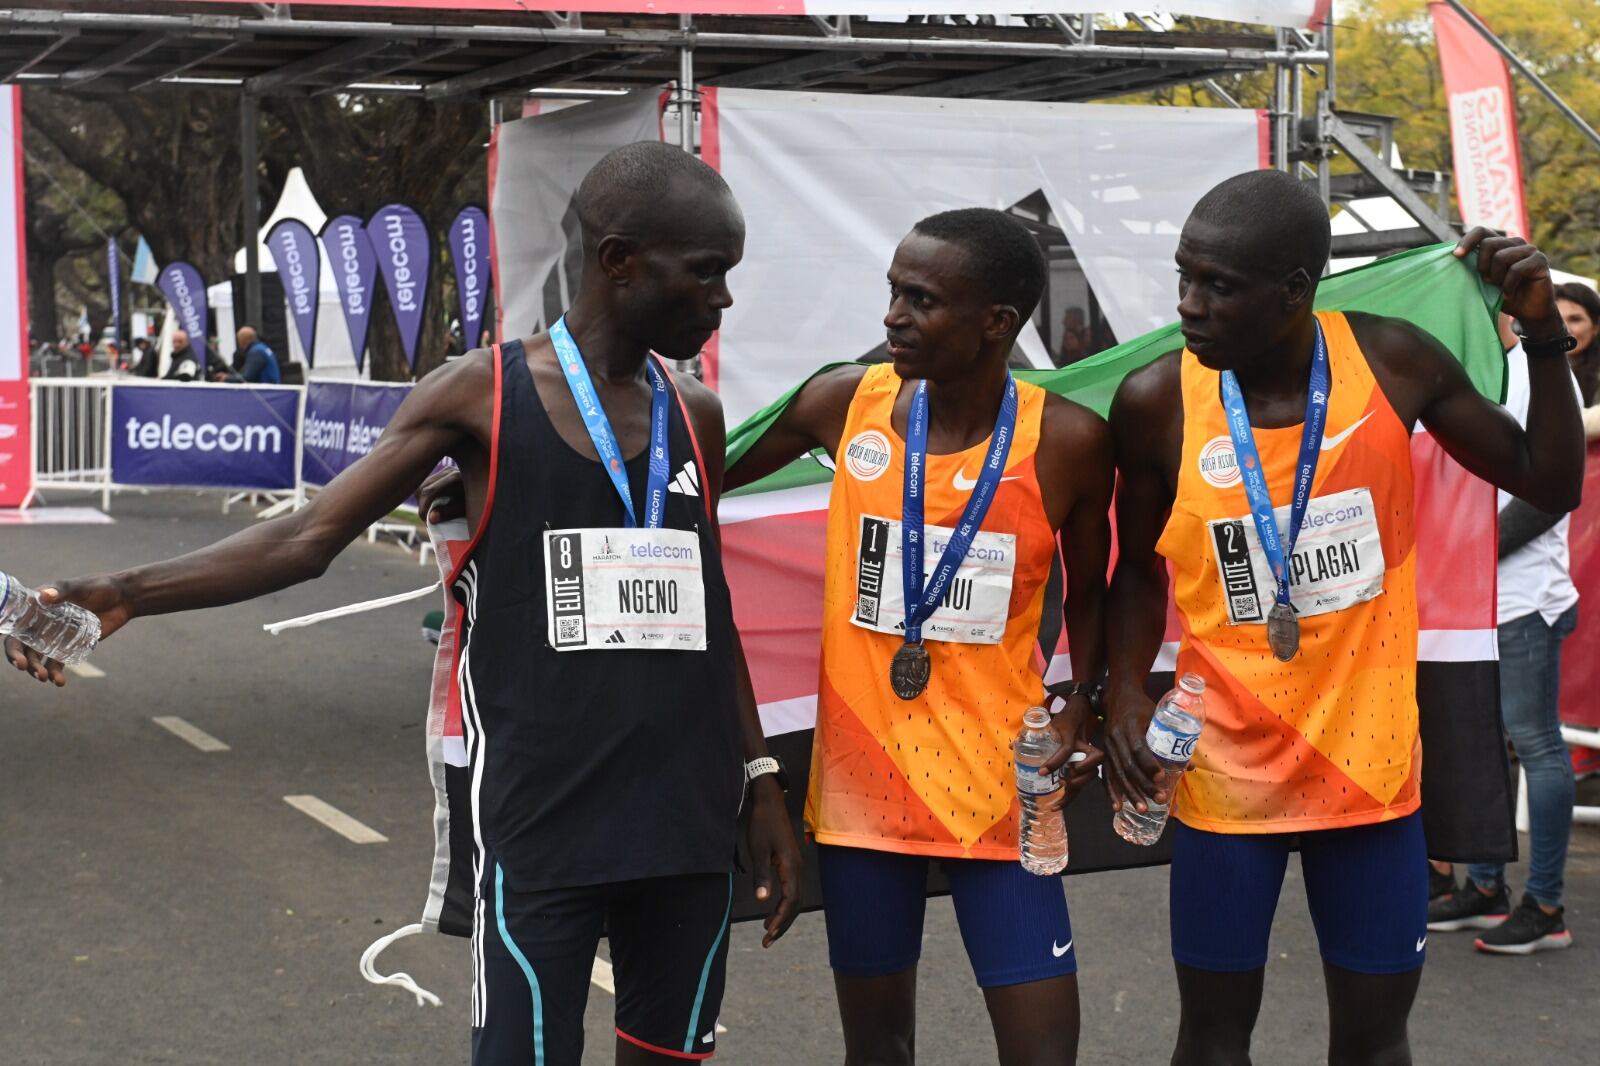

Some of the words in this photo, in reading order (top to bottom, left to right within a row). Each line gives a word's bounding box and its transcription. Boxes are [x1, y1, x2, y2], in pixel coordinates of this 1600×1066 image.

[1312, 390, 1325, 406] 42K
[125, 414, 281, 453] telecom
[304, 410, 345, 450] elecom
[347, 416, 385, 454] telec
[989, 426, 1008, 469] telecom
[909, 452, 920, 498] telecom
[1296, 464, 1311, 509] telecom
[649, 489, 661, 528] elecom
[1300, 505, 1363, 530] elecom
[869, 523, 877, 553] 1
[909, 529, 918, 543] 42K
[960, 522, 972, 537] 42K
[1224, 525, 1238, 554] 2
[560, 537, 572, 569] 8
[630, 542, 693, 559] telecom
[933, 540, 1004, 561] tecom
[1284, 539, 1360, 586] IPLAGAT
[859, 559, 881, 593] ELITE
[925, 564, 951, 606] telecom
[1224, 558, 1252, 592] ELITE
[554, 576, 581, 612] ELITE
[618, 579, 678, 614] NGENO
[939, 577, 973, 611] NUI
